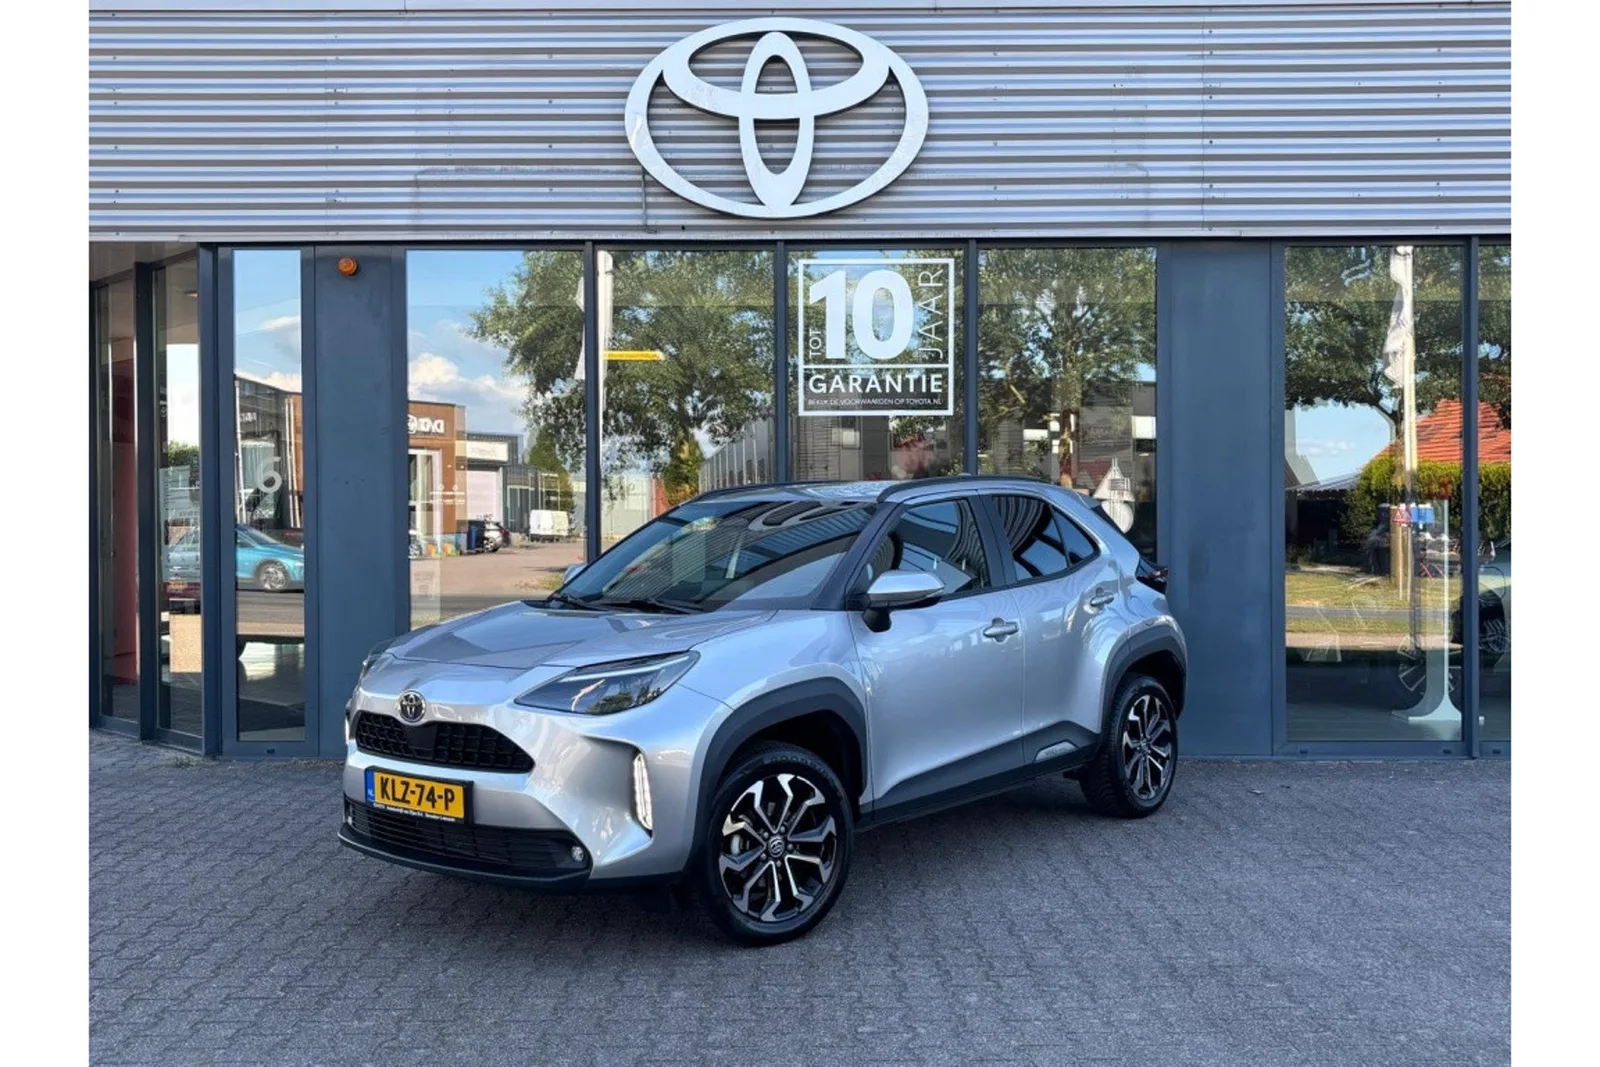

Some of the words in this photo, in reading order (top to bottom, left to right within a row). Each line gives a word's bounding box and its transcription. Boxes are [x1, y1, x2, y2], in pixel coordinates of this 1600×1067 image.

[809, 269, 914, 360] 10
[918, 269, 943, 360] JAAR
[809, 329, 822, 358] TOT
[808, 374, 943, 394] GARANTIE
[895, 398, 905, 406] OP
[380, 776, 455, 811] KLZ-74-P
